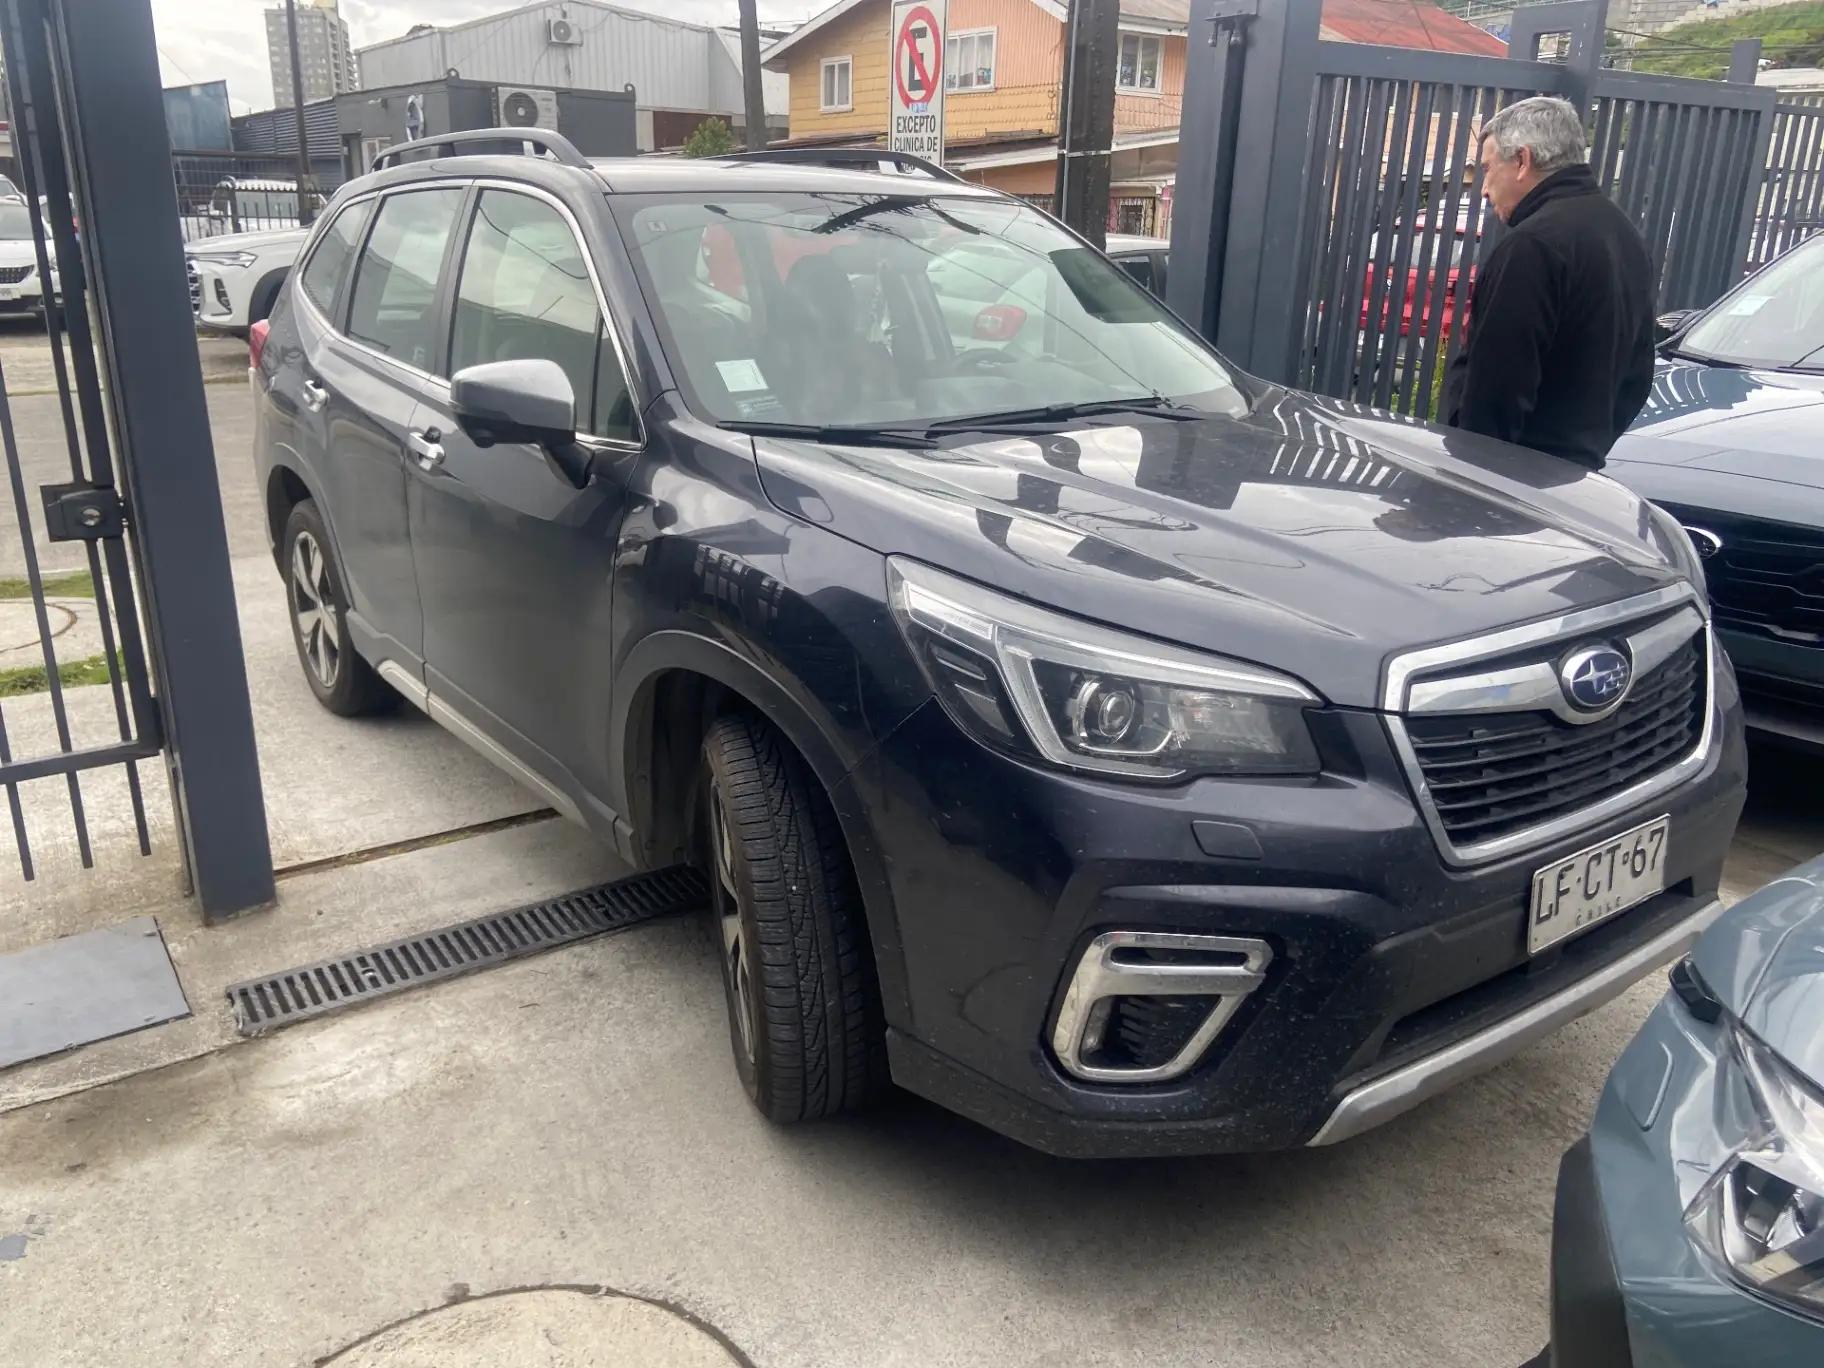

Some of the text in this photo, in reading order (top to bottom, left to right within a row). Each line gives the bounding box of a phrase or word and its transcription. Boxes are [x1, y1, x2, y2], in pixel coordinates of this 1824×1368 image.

[896, 115, 936, 134] EXCEPTO
[894, 136, 938, 152] CLINICA DE
